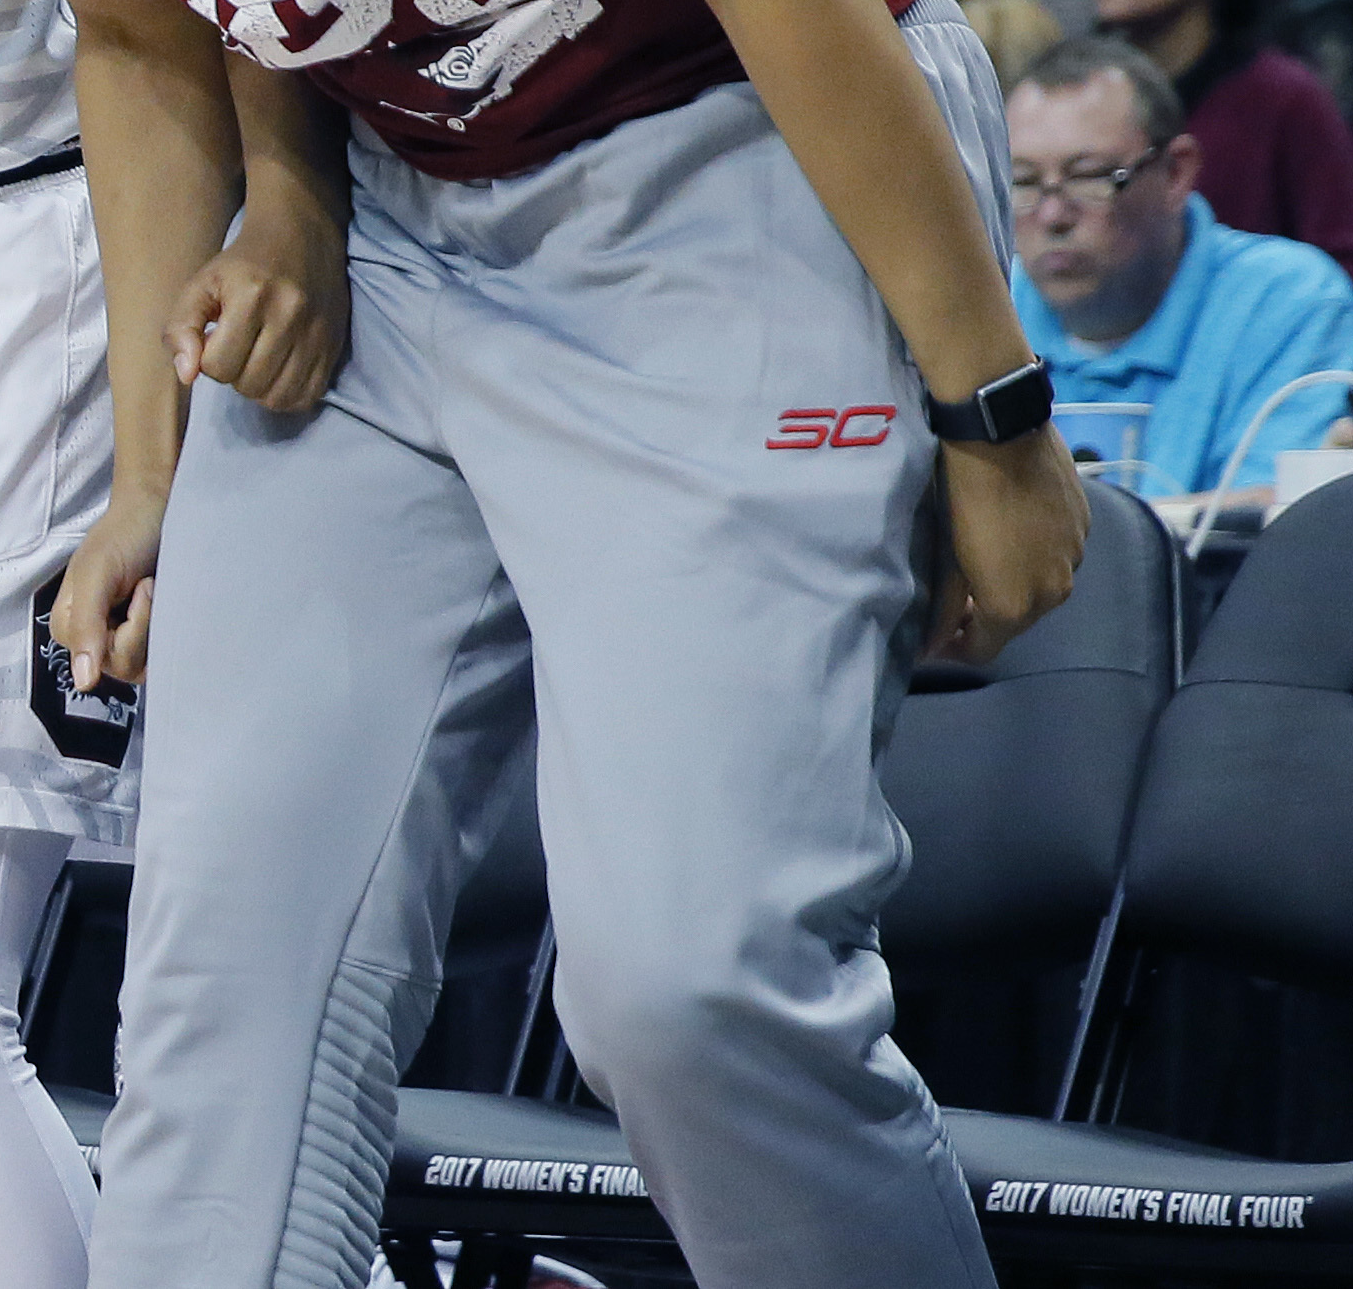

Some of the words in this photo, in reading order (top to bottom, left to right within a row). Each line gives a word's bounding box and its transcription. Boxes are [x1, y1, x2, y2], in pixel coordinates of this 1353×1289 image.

[424, 1155, 483, 1188] 2017
[482, 1159, 589, 1193] WOMEN'S
[986, 1180, 1049, 1213] 2017
[1049, 1183, 1164, 1222] WOMEN'S
[1166, 1191, 1233, 1227] FINAL
[1238, 1195, 1306, 1229] FOUR
